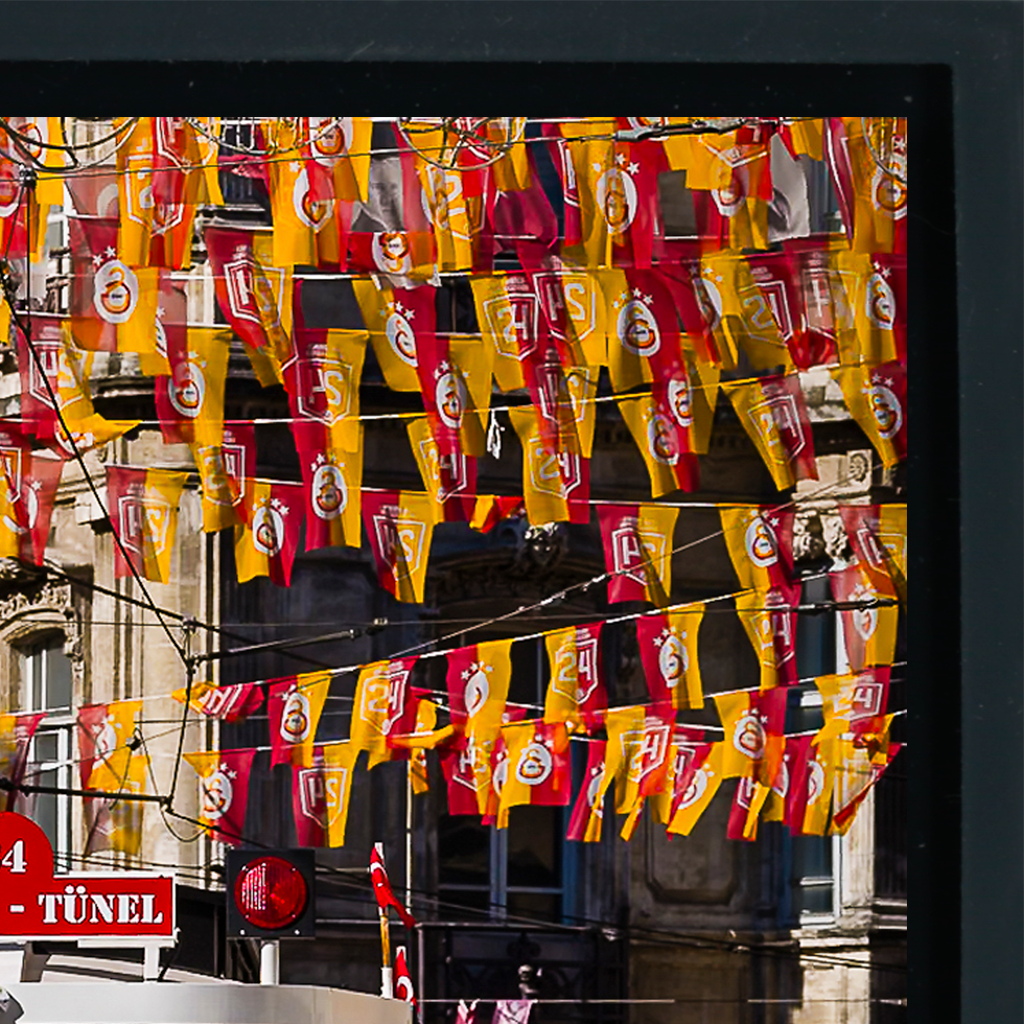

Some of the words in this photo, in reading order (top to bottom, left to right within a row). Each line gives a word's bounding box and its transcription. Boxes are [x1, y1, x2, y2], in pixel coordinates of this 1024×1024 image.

[497, 302, 528, 342] 24
[556, 650, 592, 681] 24
[366, 681, 400, 713] 24
[8, 904, 26, 914] -
[38, 885, 164, 925] TÜNEL
